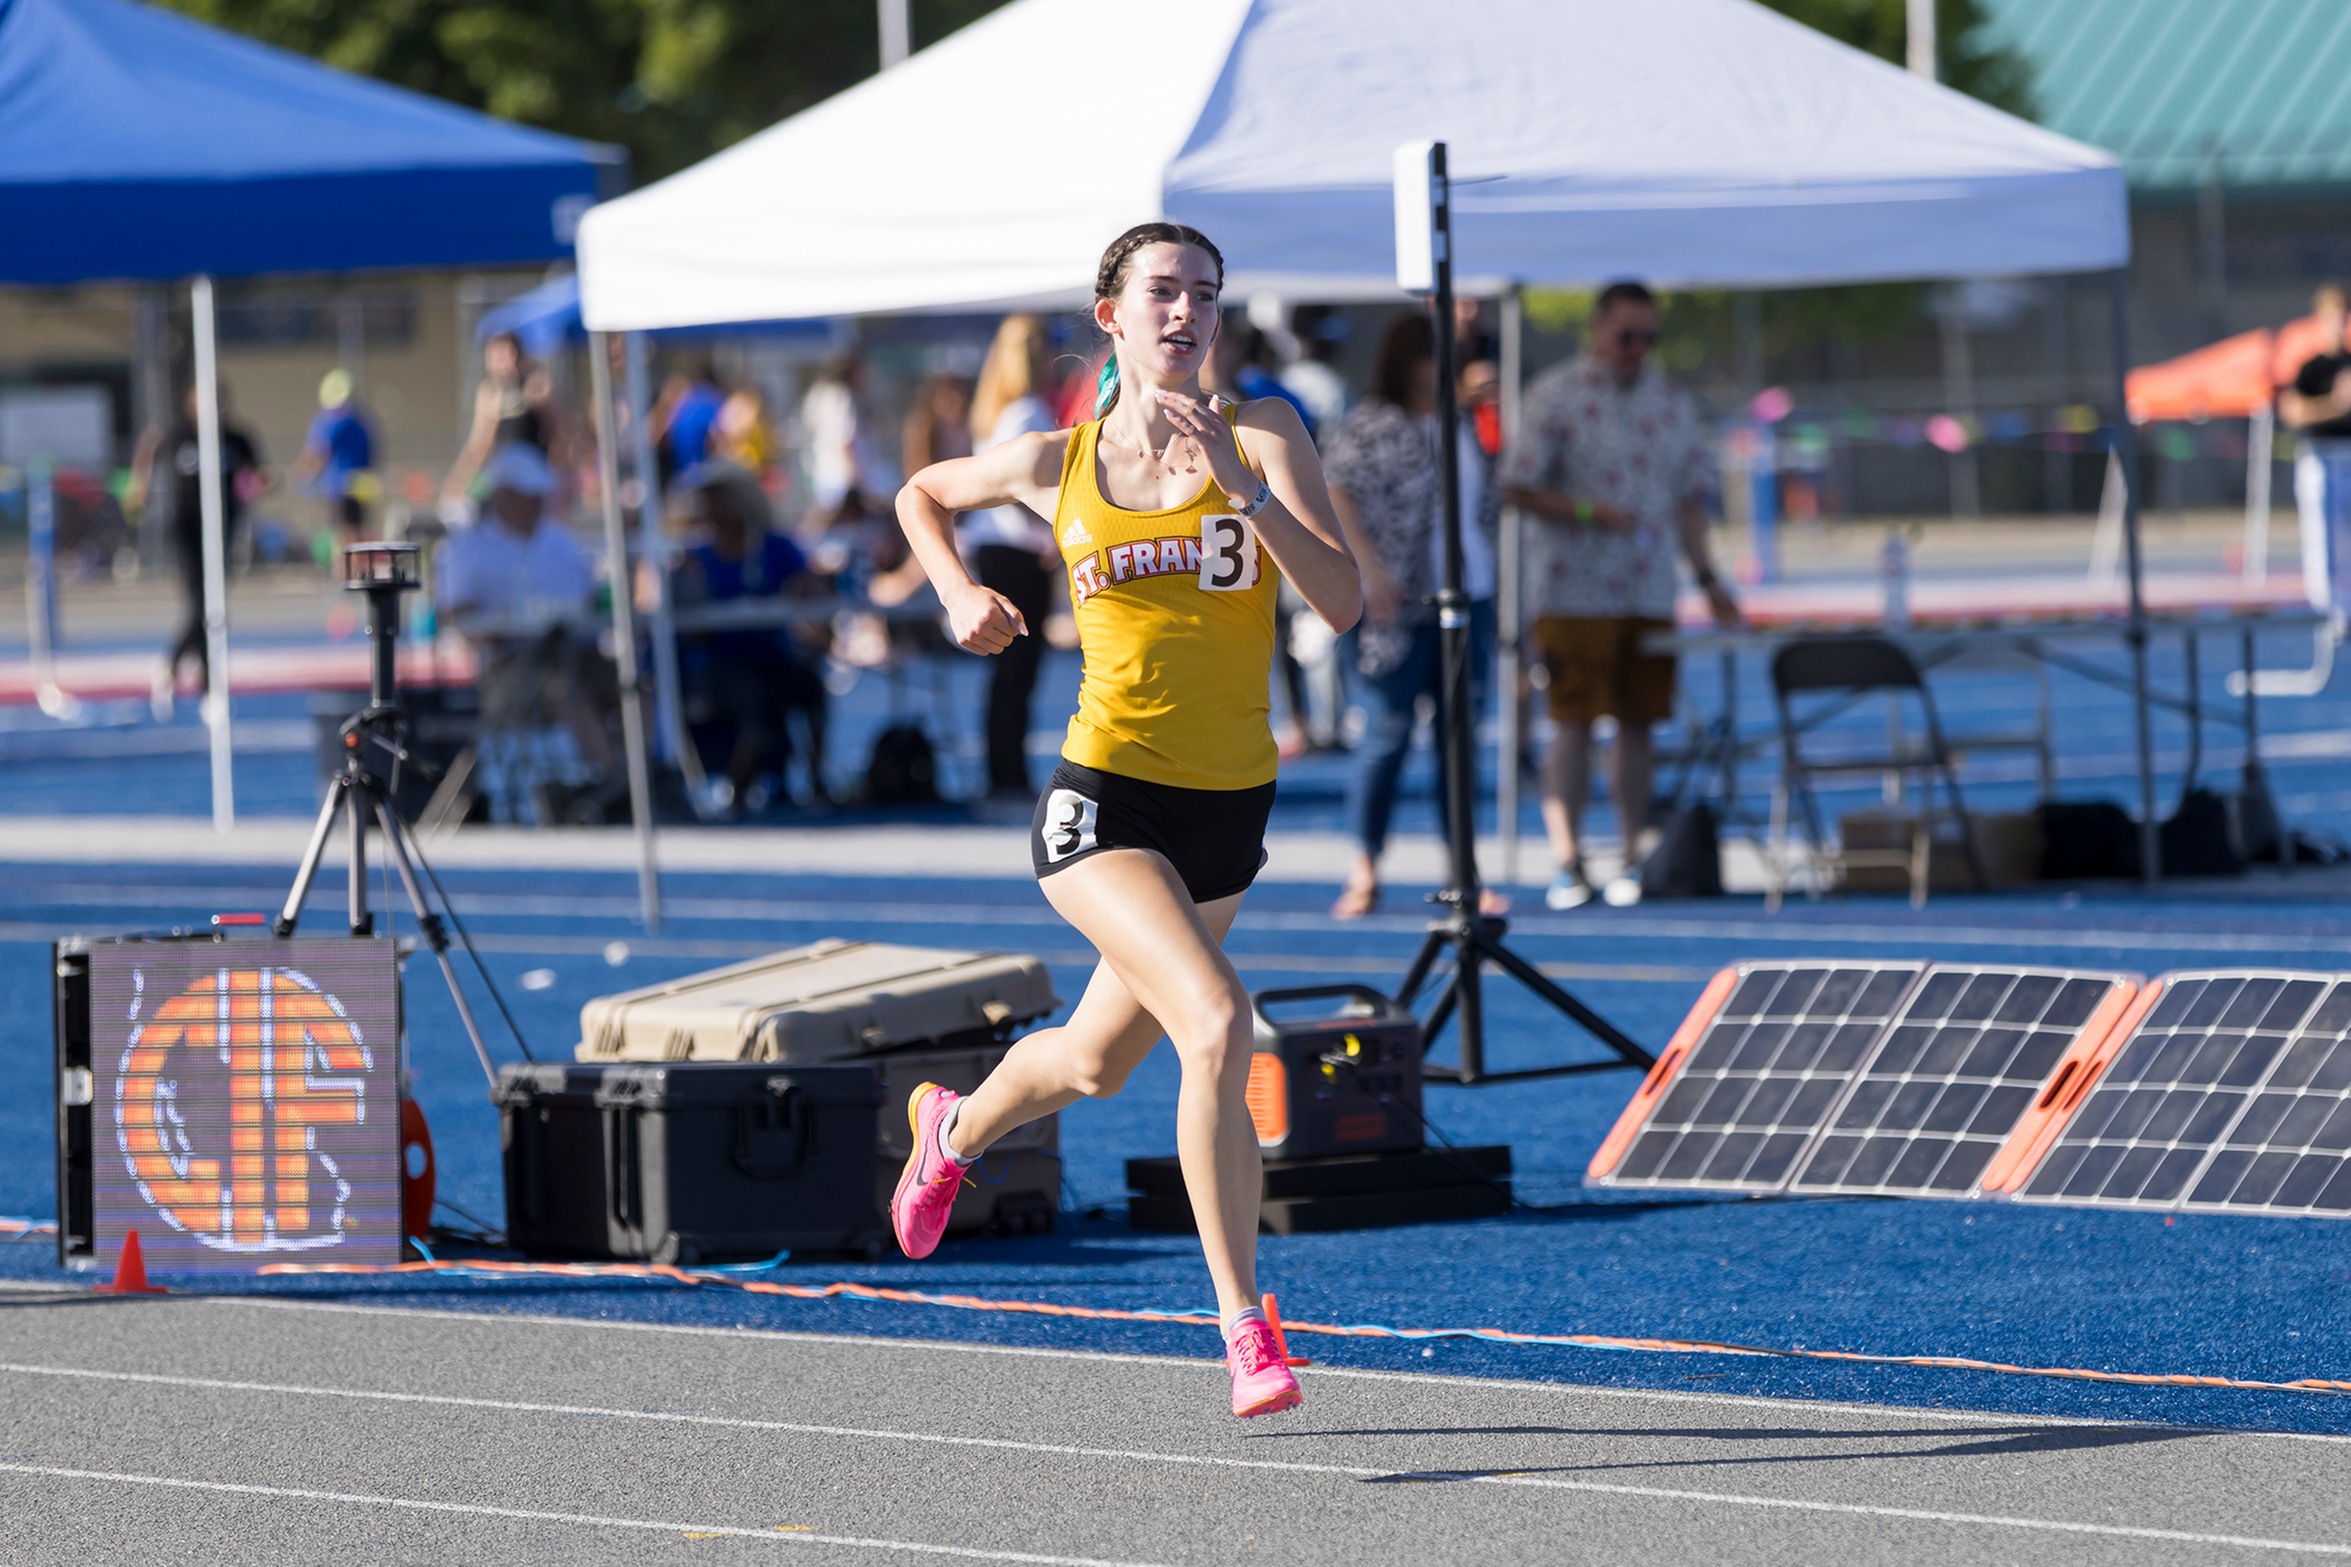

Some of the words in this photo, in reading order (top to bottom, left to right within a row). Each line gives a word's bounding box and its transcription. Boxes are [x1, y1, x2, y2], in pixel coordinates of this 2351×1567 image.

[1061, 533, 1093, 549] adidas
[1211, 518, 1244, 588] 3
[1071, 551, 1111, 607] ST.
[1055, 794, 1084, 856] 3
